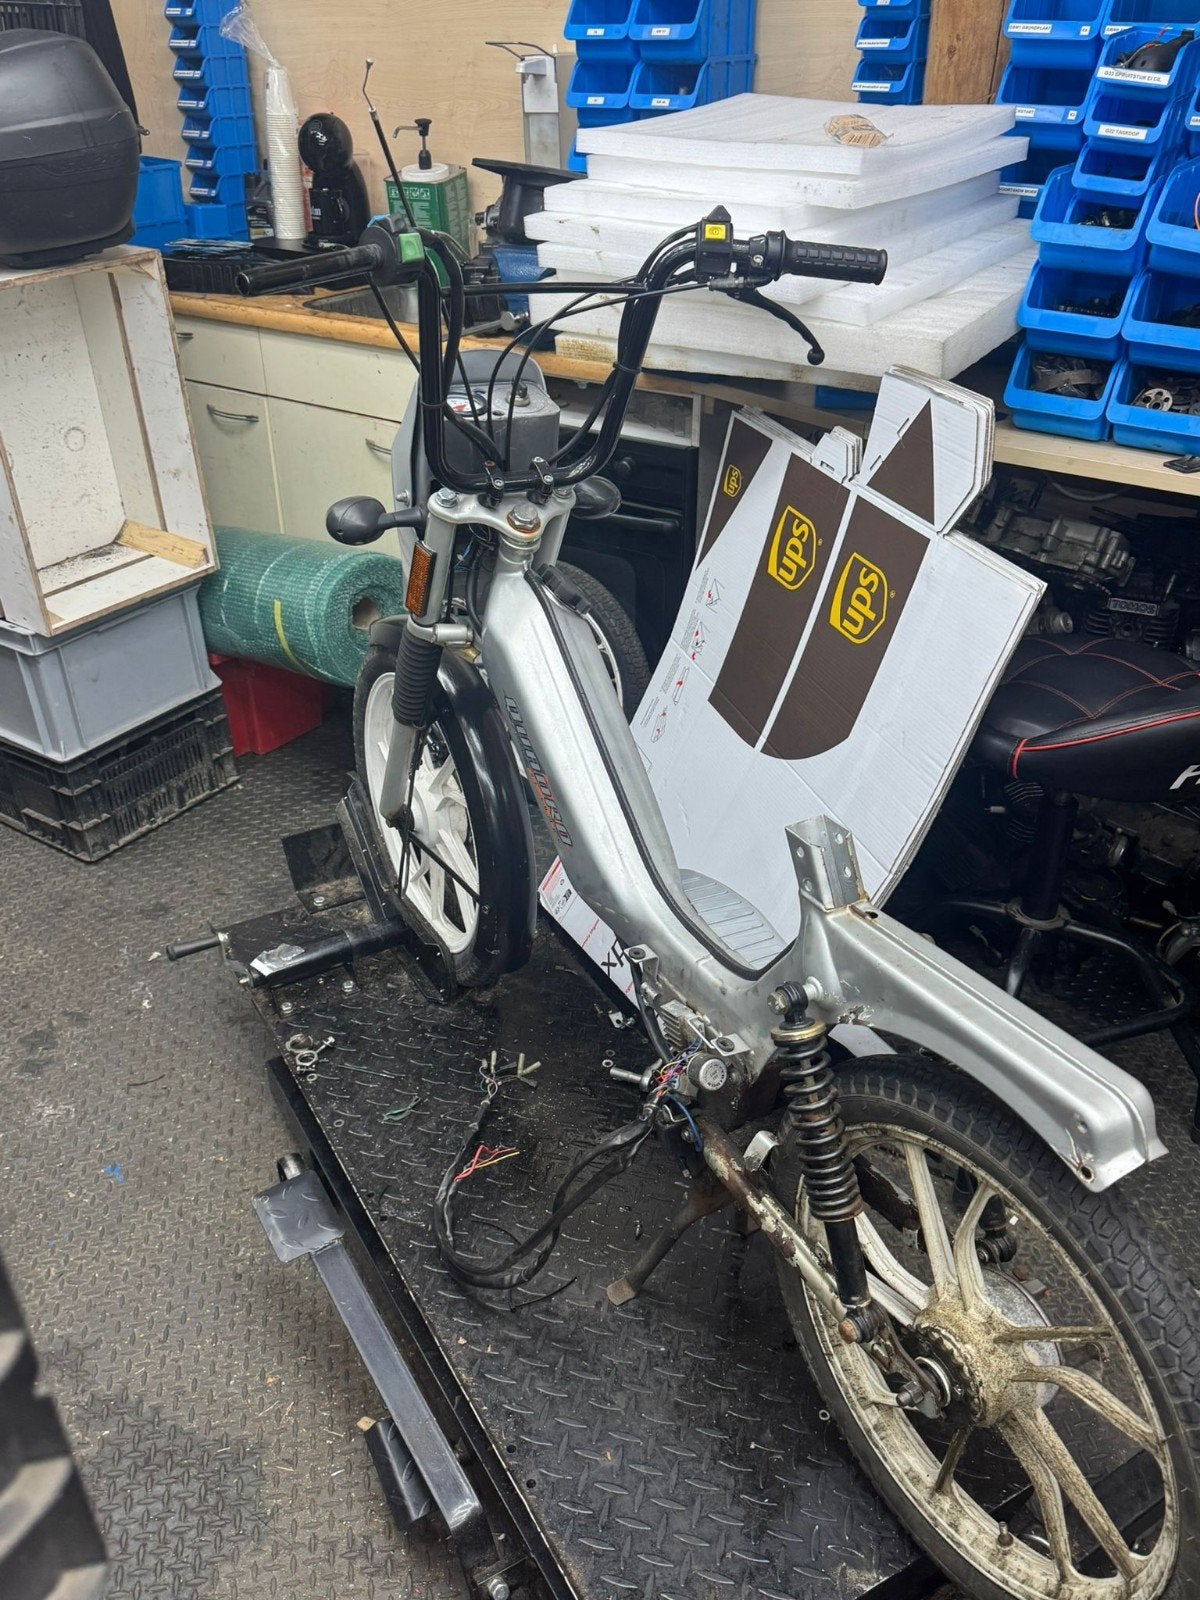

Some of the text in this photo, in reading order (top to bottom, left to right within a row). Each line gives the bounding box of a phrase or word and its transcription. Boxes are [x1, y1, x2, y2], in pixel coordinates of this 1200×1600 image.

[777, 518, 810, 583] ups
[841, 566, 880, 636] ups
[1111, 599, 1157, 615] TOMOS
